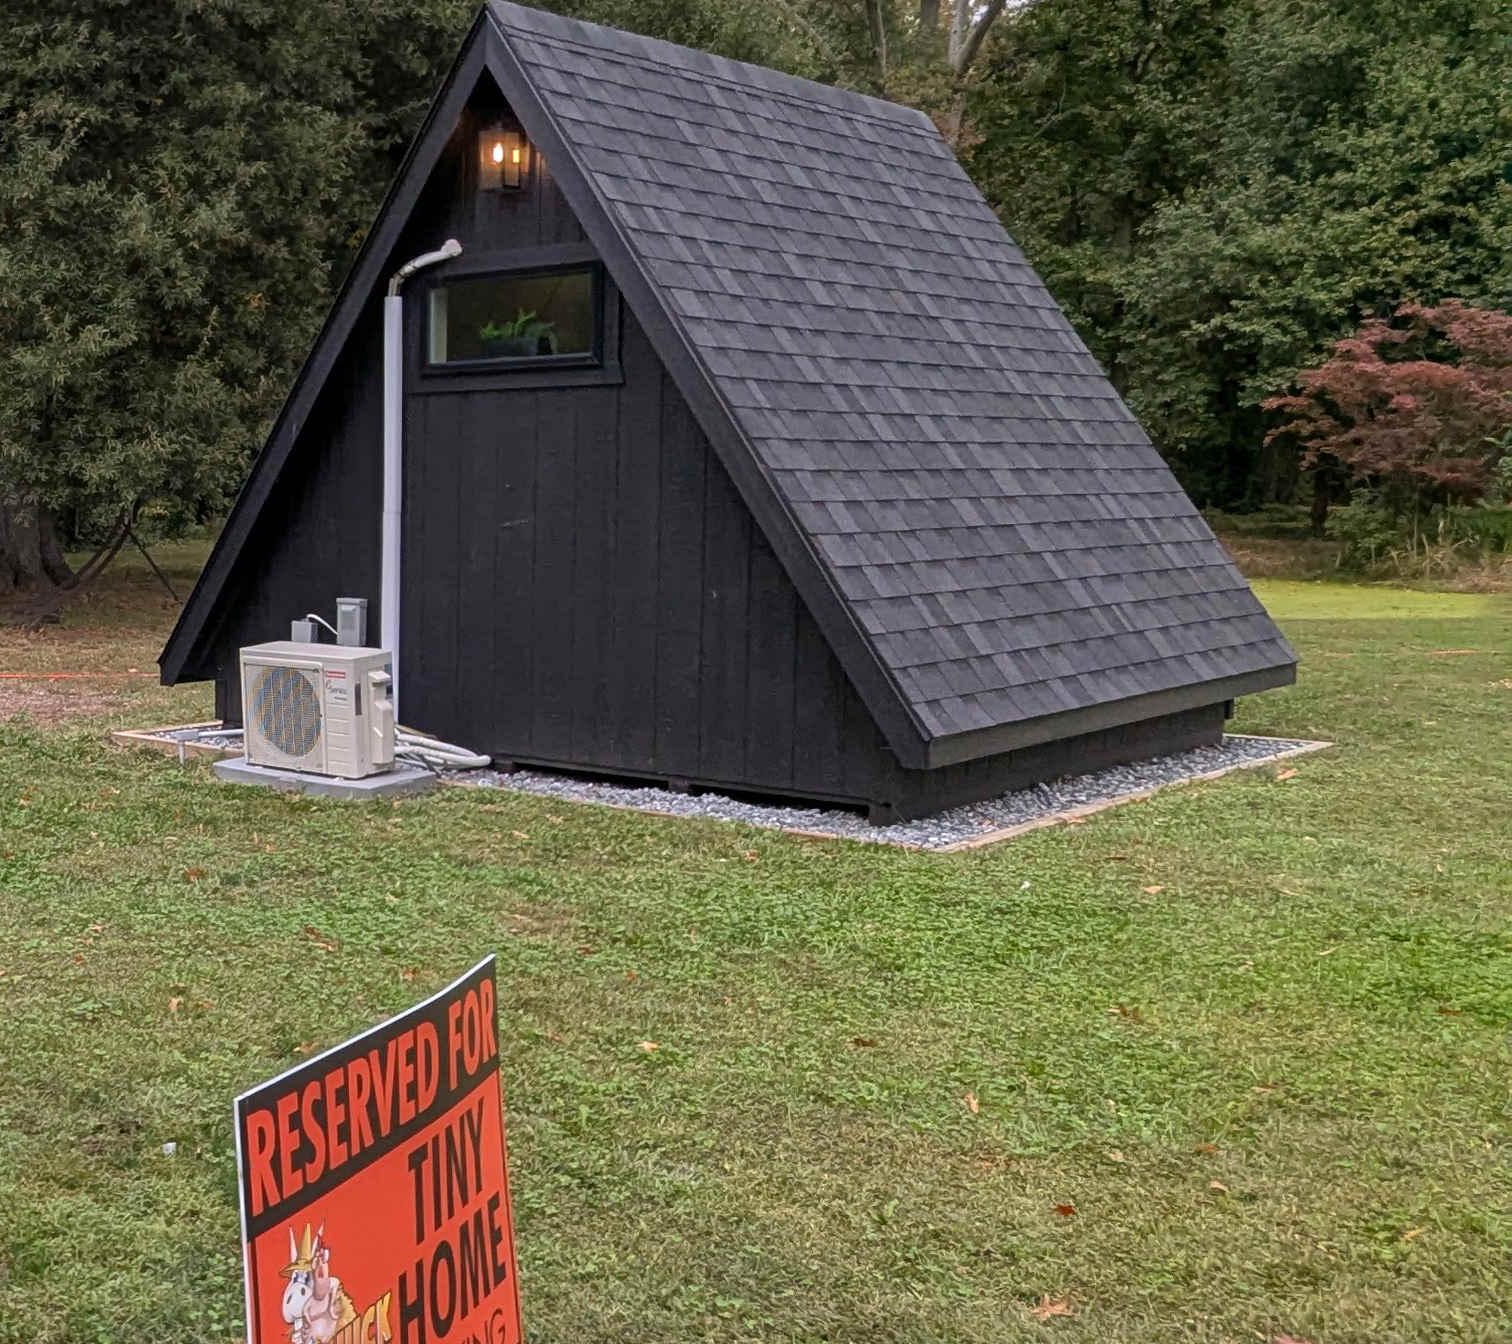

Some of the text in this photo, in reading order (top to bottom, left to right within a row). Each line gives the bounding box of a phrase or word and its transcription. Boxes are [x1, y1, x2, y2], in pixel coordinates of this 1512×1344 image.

[245, 978, 497, 1217] RESERVED FOR
[407, 1096, 485, 1246] TINY
